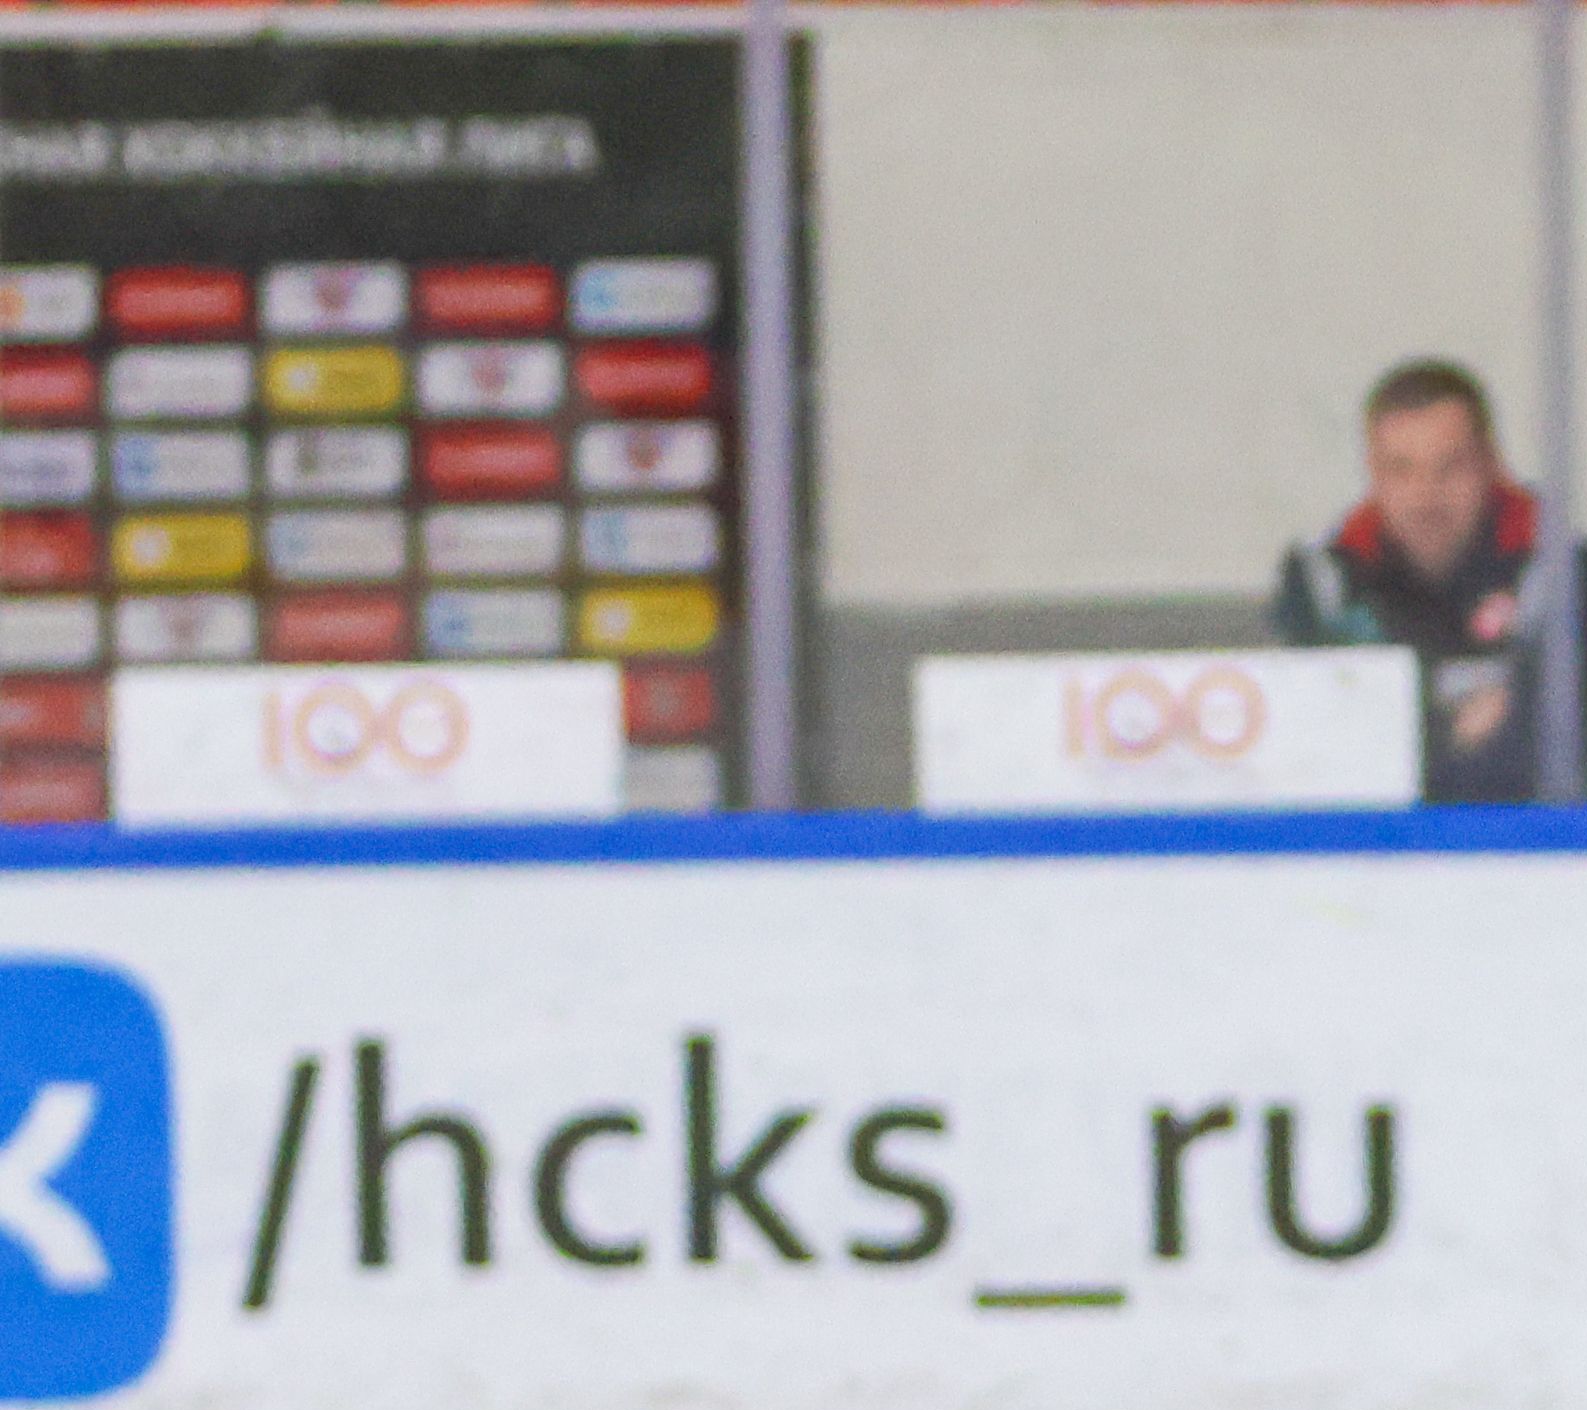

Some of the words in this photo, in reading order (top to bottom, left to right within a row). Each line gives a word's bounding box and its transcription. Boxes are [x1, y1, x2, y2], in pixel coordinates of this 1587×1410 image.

[264, 682, 470, 776] 100
[1063, 664, 1268, 764] 100
[243, 1034, 1398, 1312] /hcks_ru
